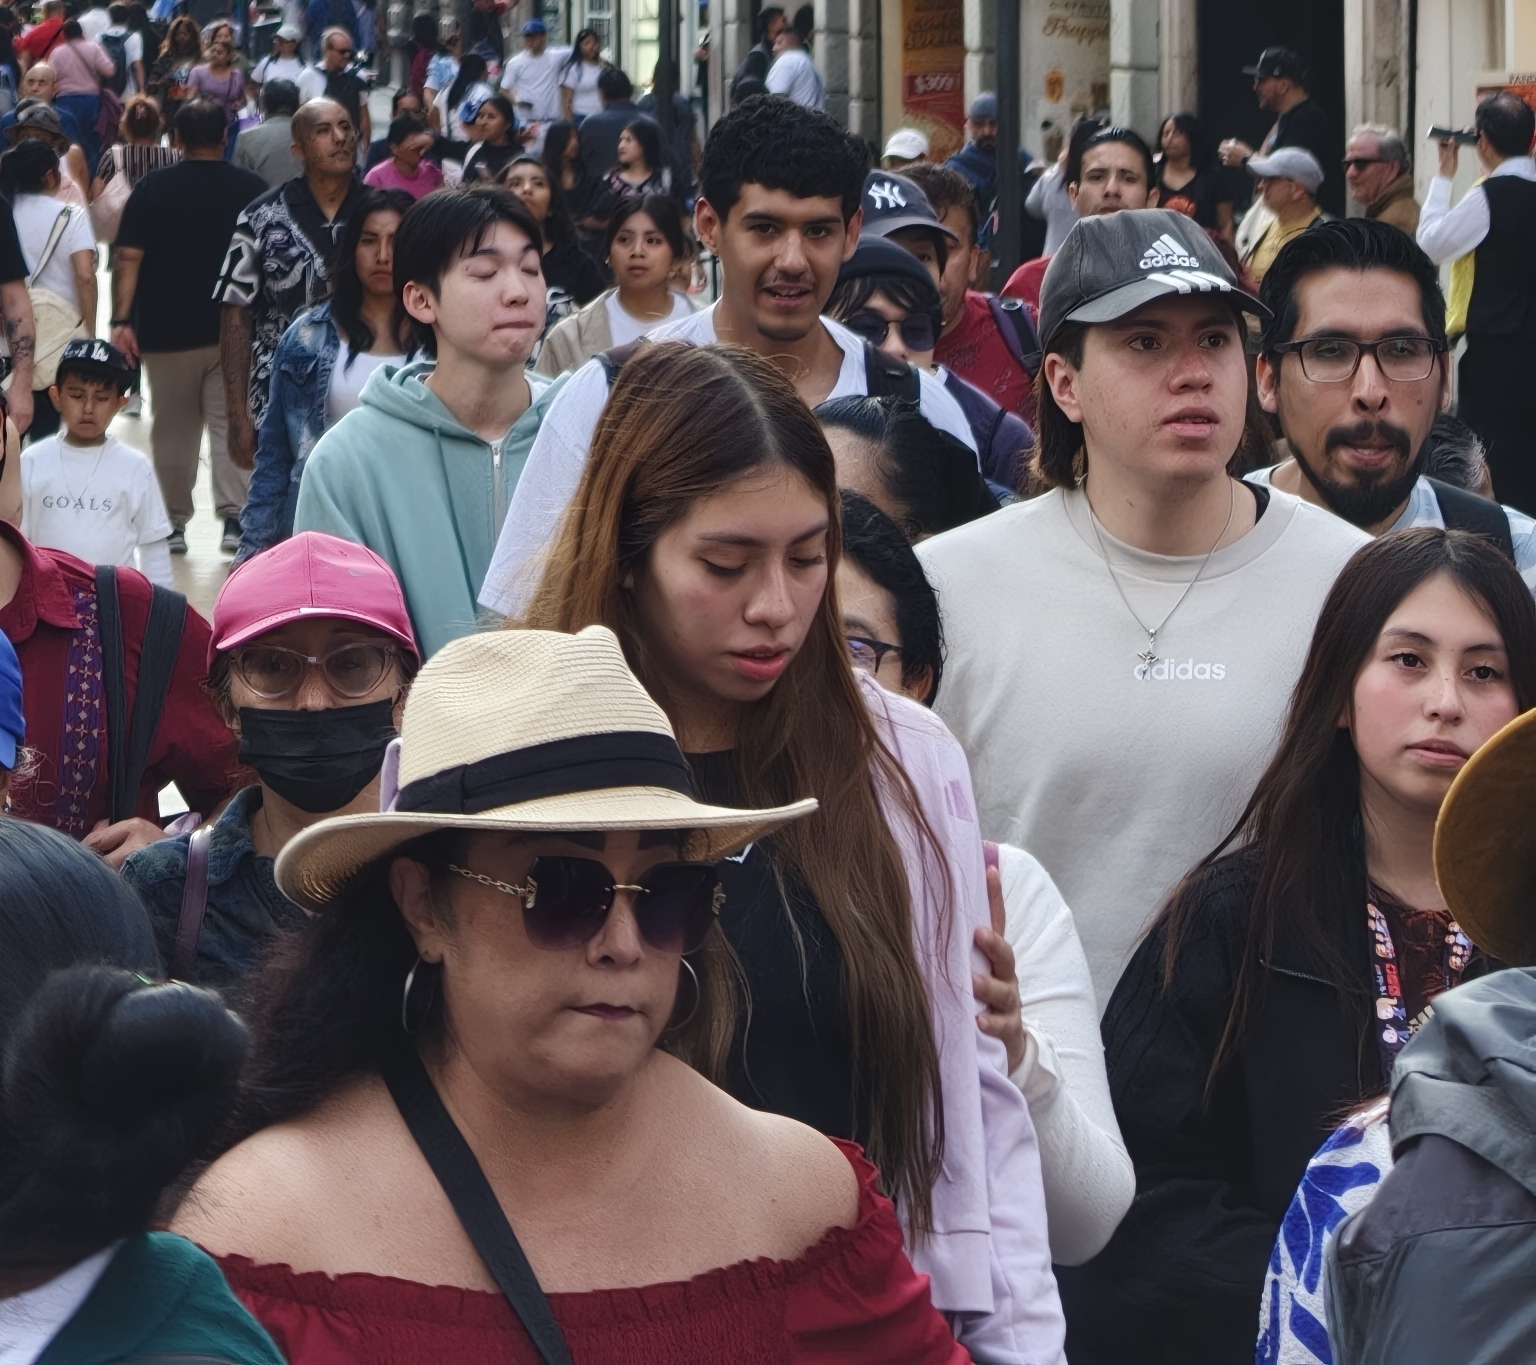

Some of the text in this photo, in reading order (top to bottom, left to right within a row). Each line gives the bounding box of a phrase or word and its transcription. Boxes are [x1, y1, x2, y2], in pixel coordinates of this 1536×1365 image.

[1139, 254, 1200, 270] adidas
[42, 495, 113, 512] GOALS
[1133, 657, 1226, 681] adidas
